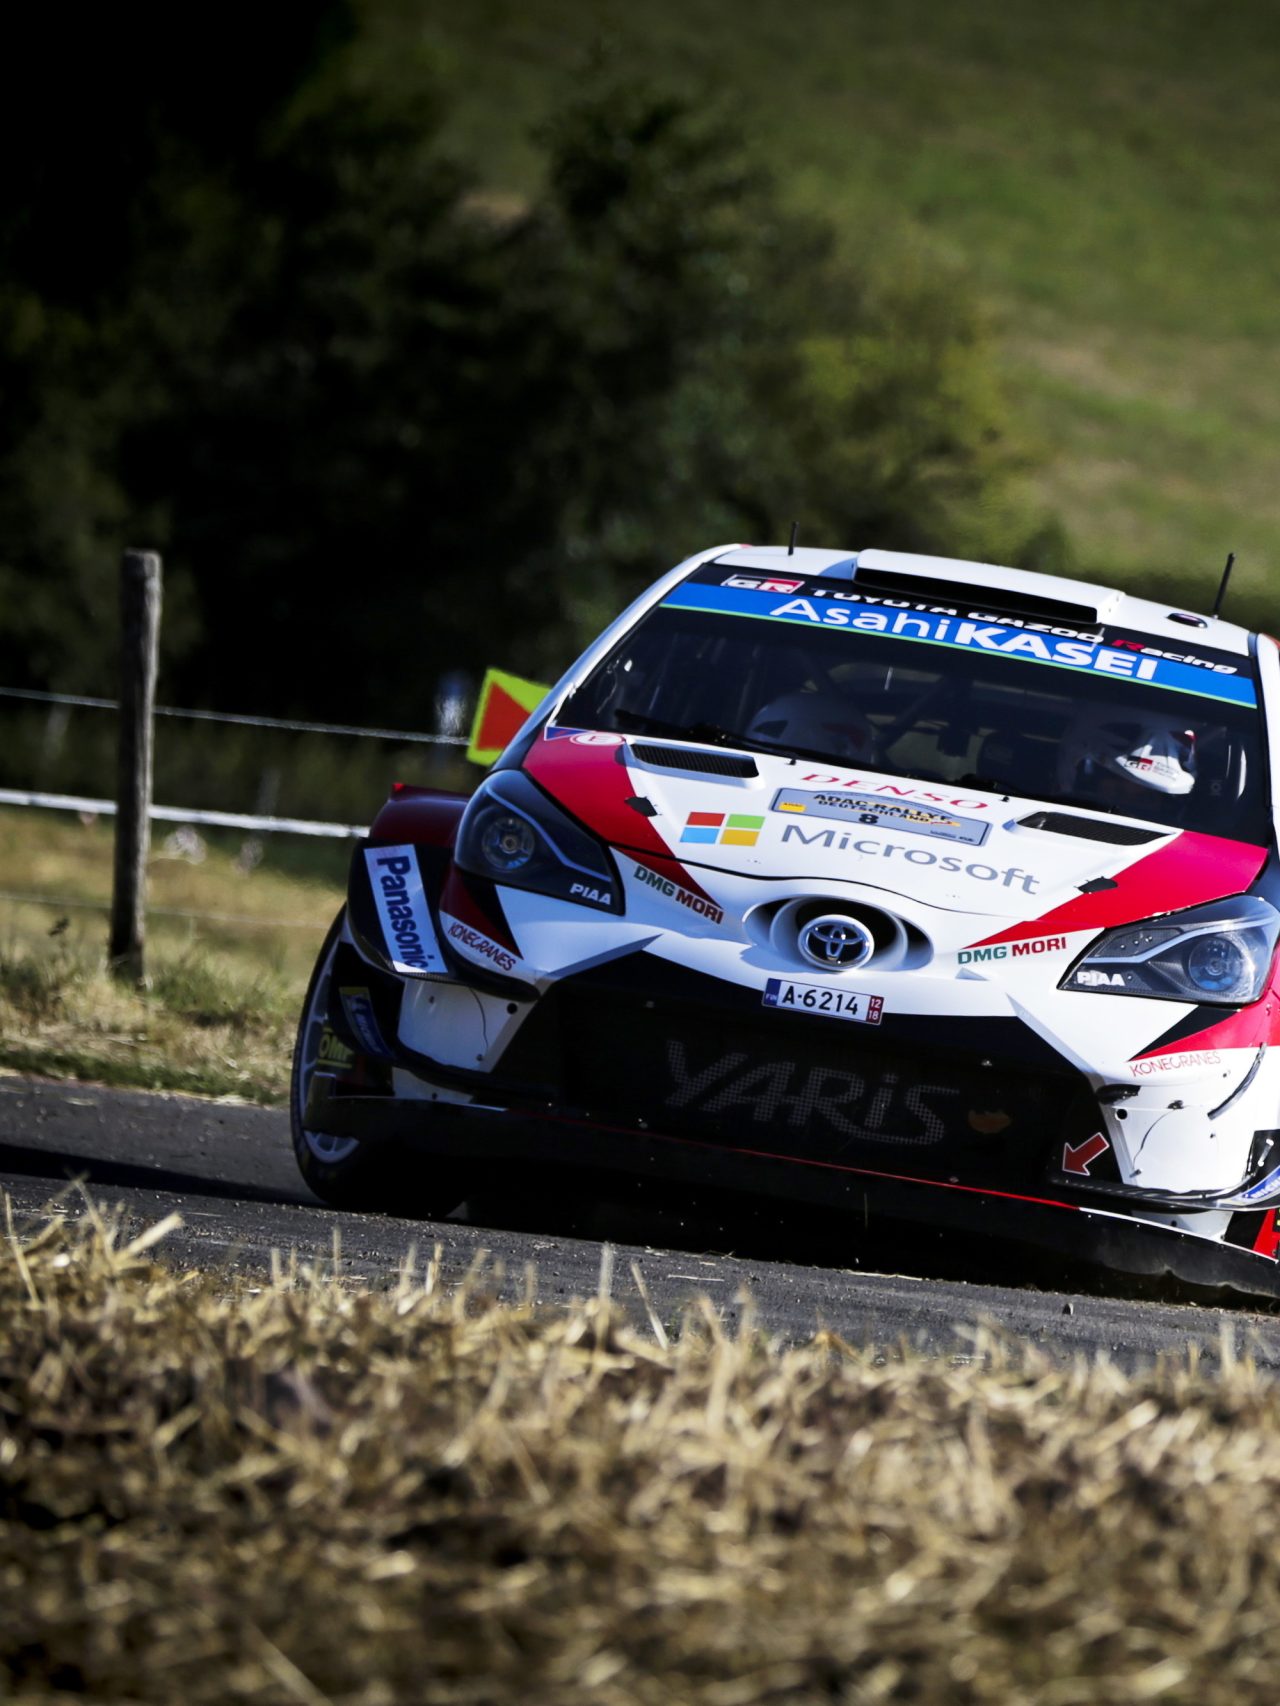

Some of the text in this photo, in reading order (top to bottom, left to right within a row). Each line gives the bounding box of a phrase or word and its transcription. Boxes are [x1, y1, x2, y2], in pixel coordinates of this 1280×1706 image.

[727, 578, 795, 593] GR
[968, 612, 1104, 644] GAZOO
[1112, 639, 1238, 675] Racing
[800, 774, 988, 809] DENSO
[814, 794, 953, 822] ADAC RALLYE
[818, 800, 931, 822] DEUTSCHLAND
[858, 813, 880, 825] 8
[781, 824, 1041, 895] Microsoft
[569, 882, 612, 906] PIAA
[634, 865, 724, 925] DMG MORI
[376, 855, 435, 969] Panasonic
[448, 921, 517, 972] KONECRANES
[957, 936, 1067, 965] DMG MORI
[1077, 970, 1126, 987] PIAA
[868, 1010, 879, 1020] 18
[871, 998, 881, 1008] 12
[1129, 1051, 1221, 1077] KONECRANES
